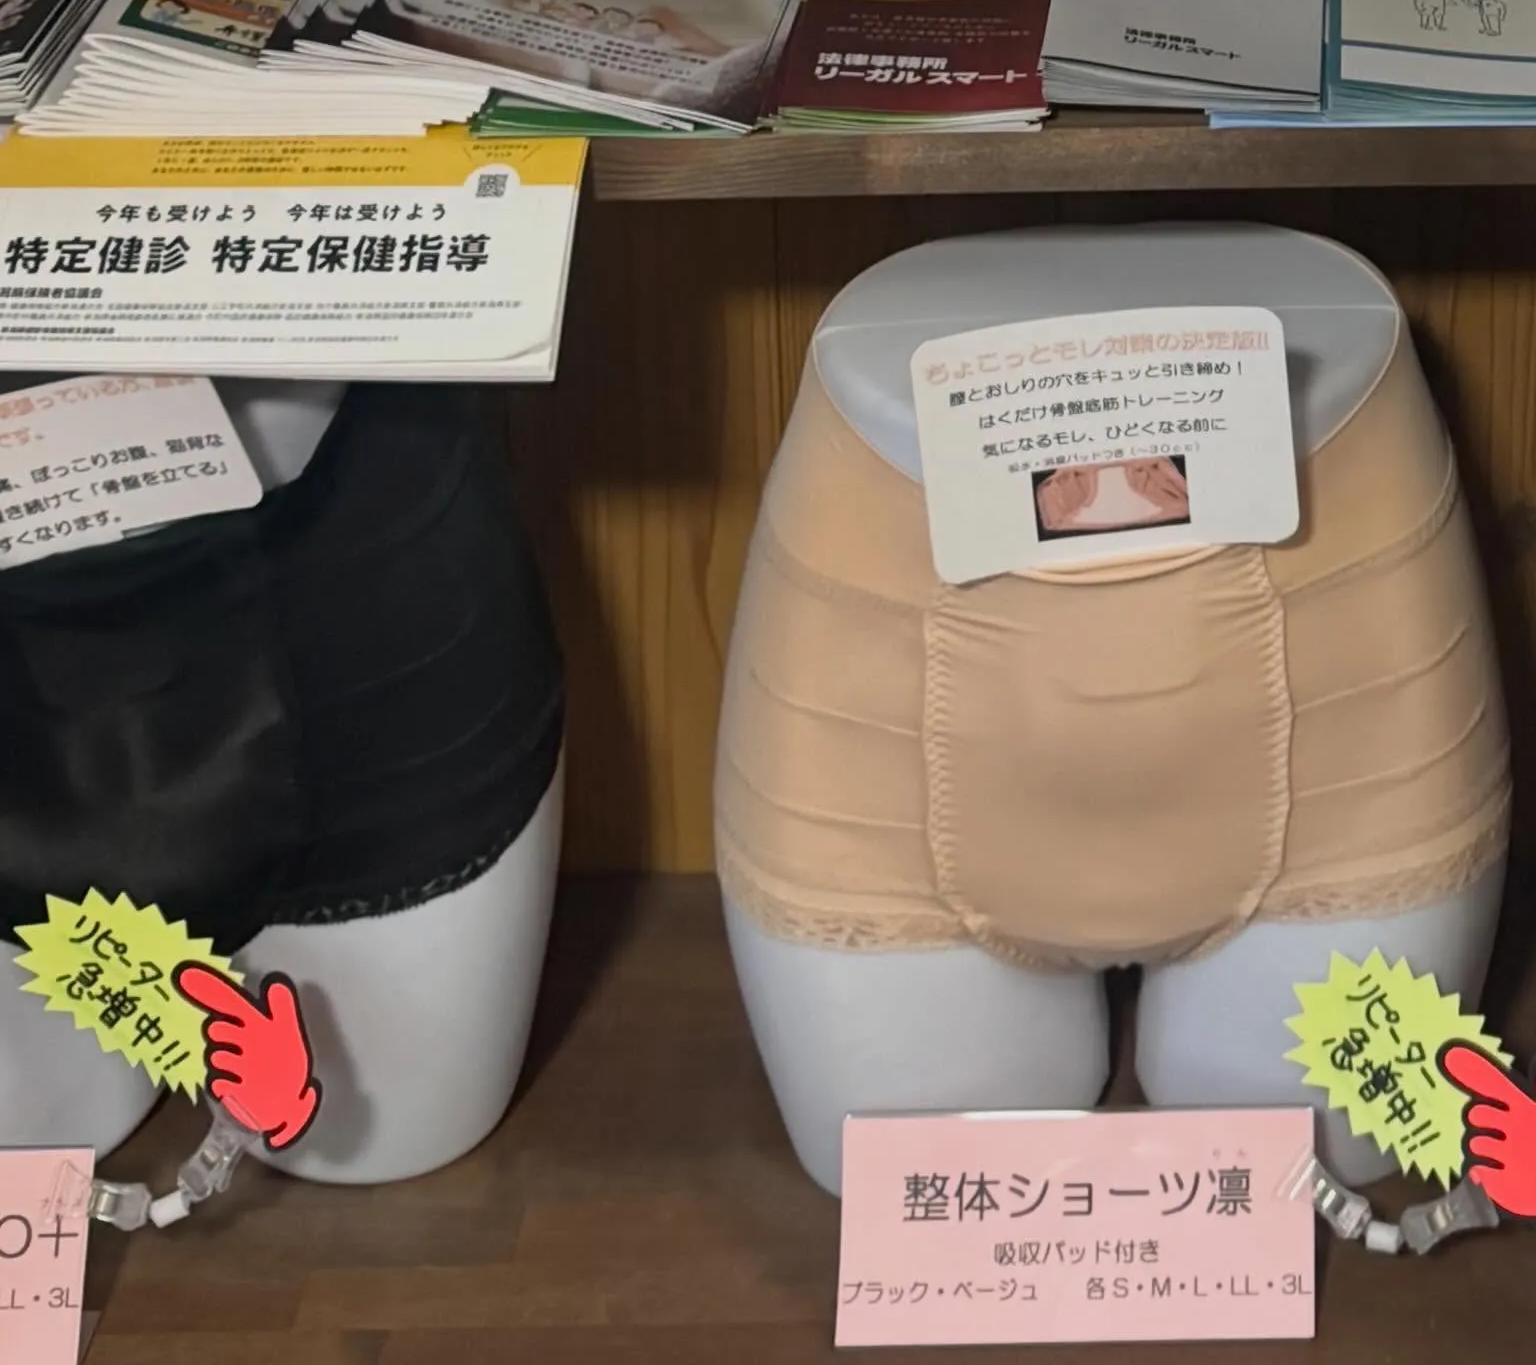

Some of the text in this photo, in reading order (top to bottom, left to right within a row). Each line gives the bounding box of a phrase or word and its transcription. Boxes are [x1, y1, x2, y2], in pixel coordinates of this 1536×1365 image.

[95, 203, 449, 224] 今年も受けよう 今年は受けよう
[4, 233, 491, 275] 特定健診 特定保健指導
[68, 914, 171, 1004] リピーター
[1345, 972, 1438, 1091] リピーター
[902, 1165, 1255, 1224] 整体ショーツ凛
[993, 1239, 1161, 1268] 吸収パッド付き
[841, 1279, 1040, 1307] ブラック・ベージュ
